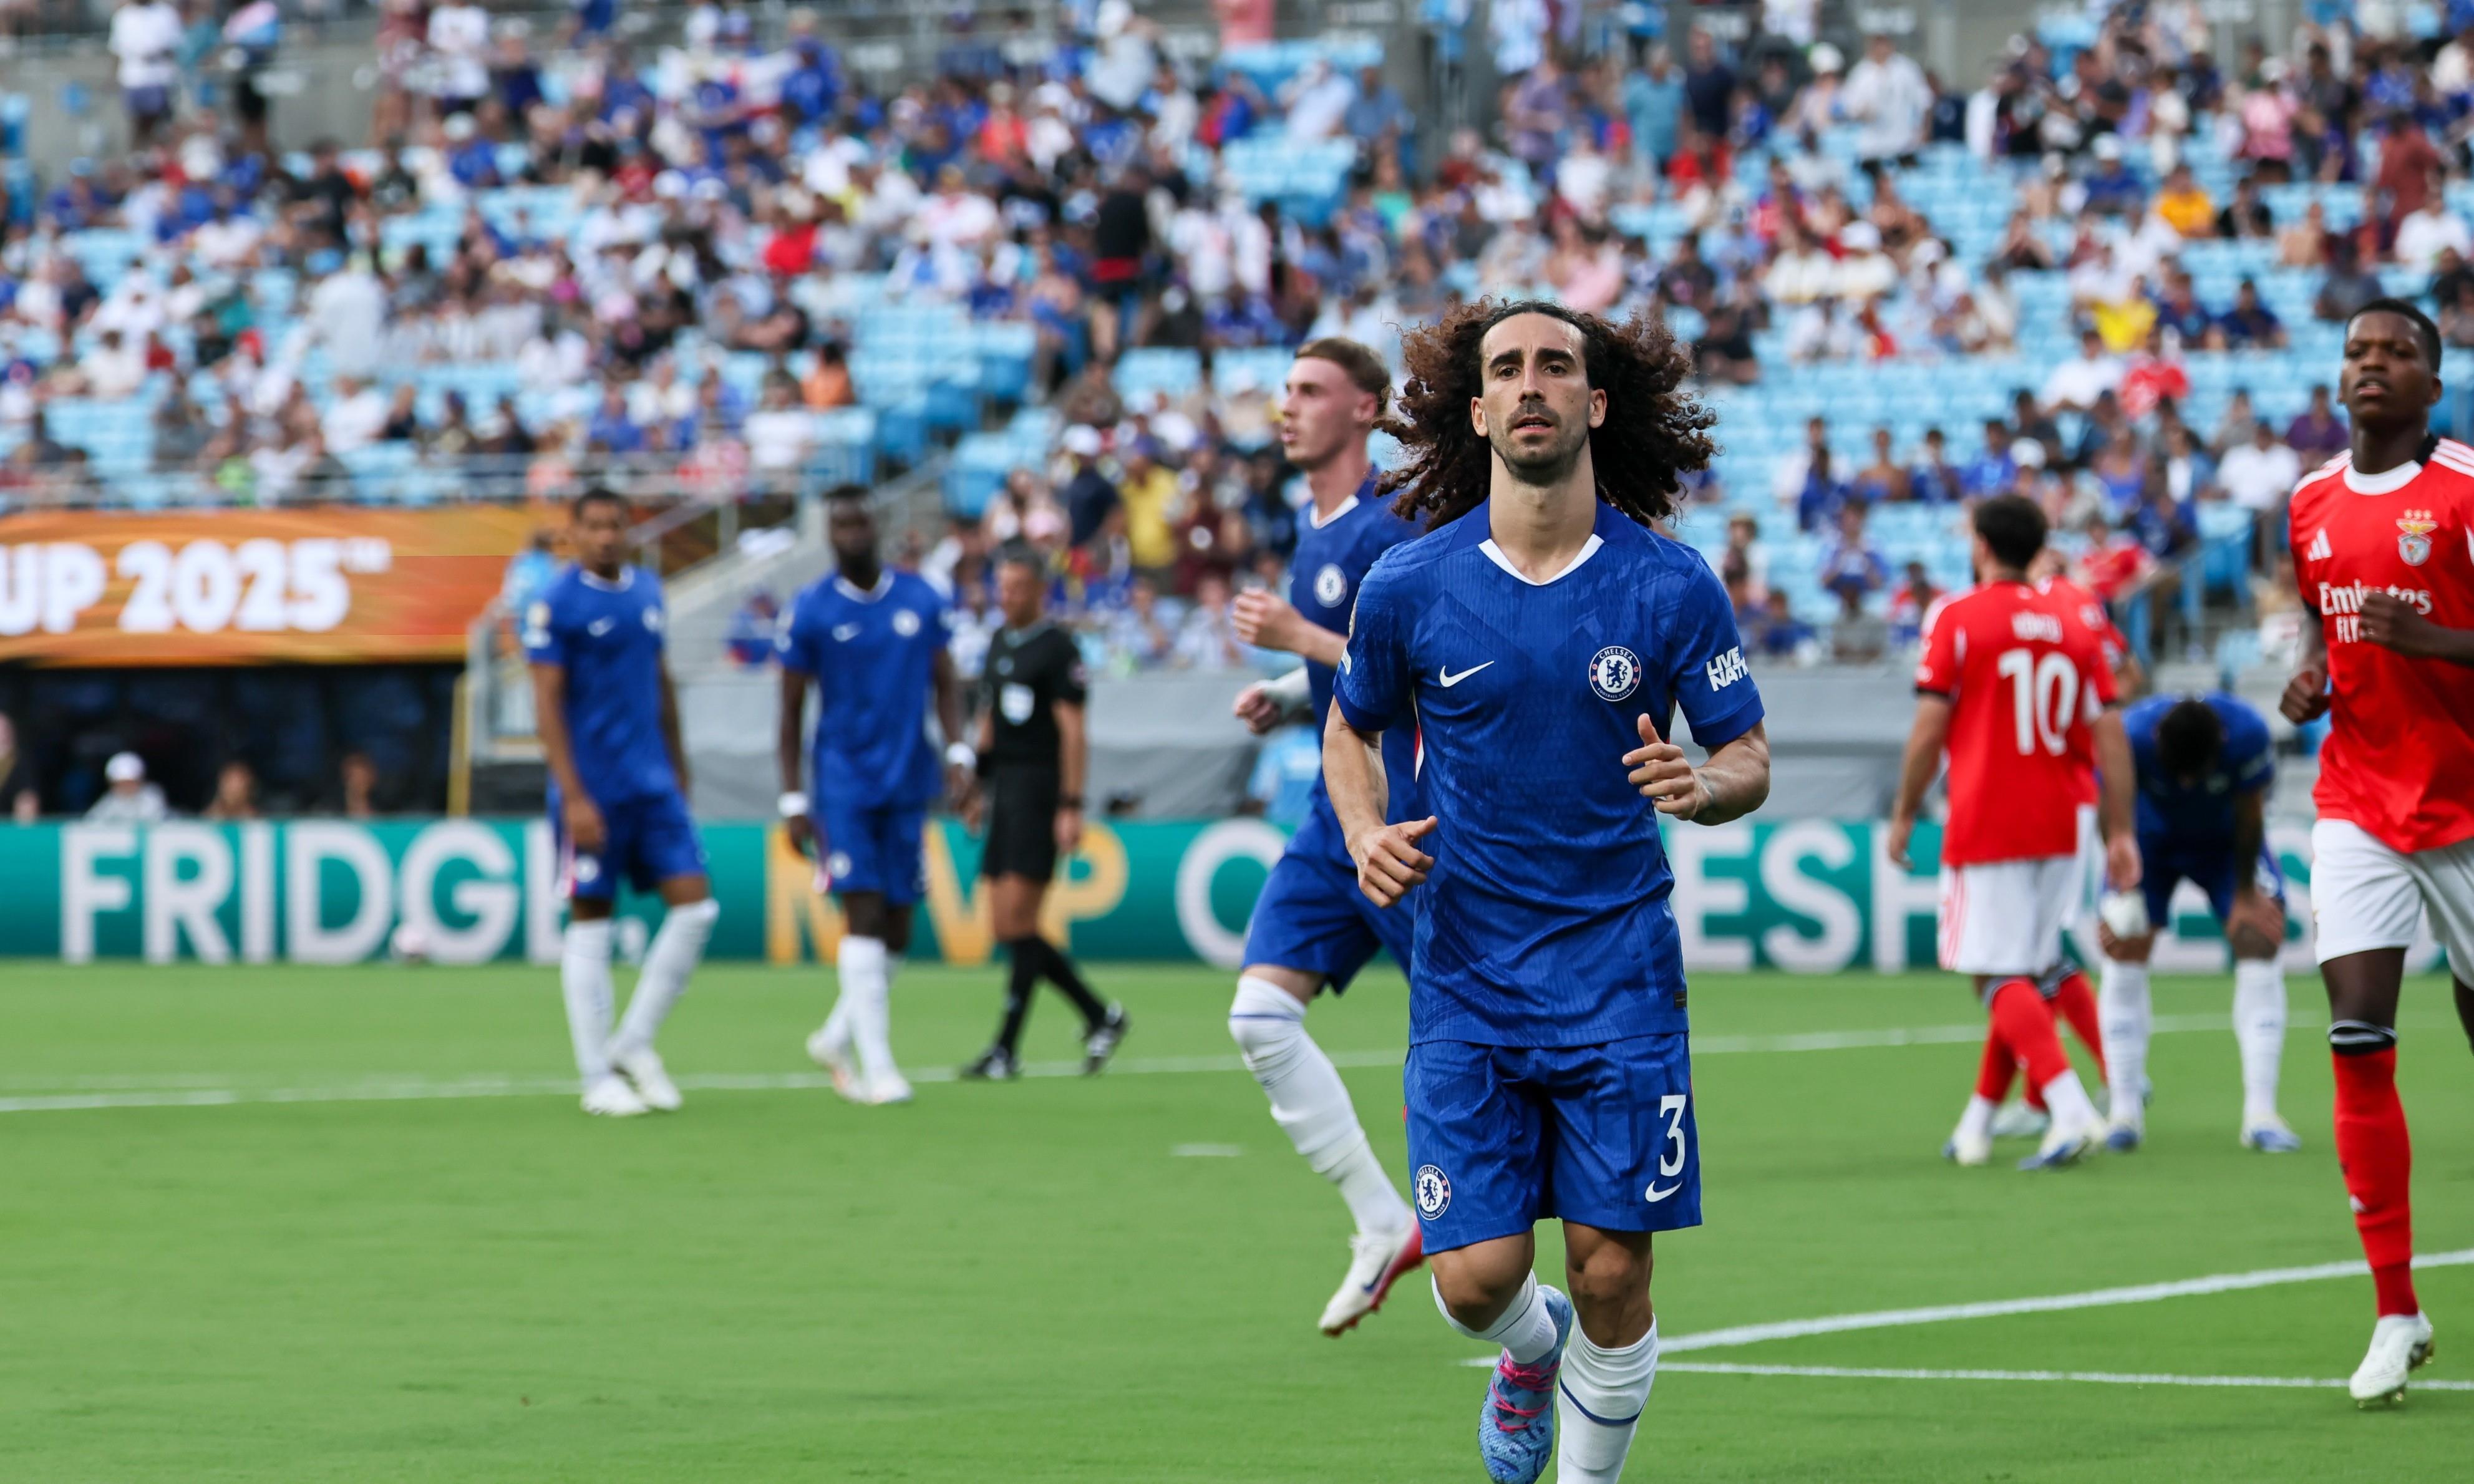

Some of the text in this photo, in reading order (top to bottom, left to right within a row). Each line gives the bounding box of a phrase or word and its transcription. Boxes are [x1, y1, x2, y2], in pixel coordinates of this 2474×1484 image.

[1598, 648, 1633, 661] CHELSEA
[1706, 646, 1740, 677] LIVE
[1597, 687, 1618, 699] FOOTBALL
[1997, 647, 2079, 756] 10
[1659, 1094, 1687, 1177] 3
[1417, 1167, 1438, 1182] CHELSEA
